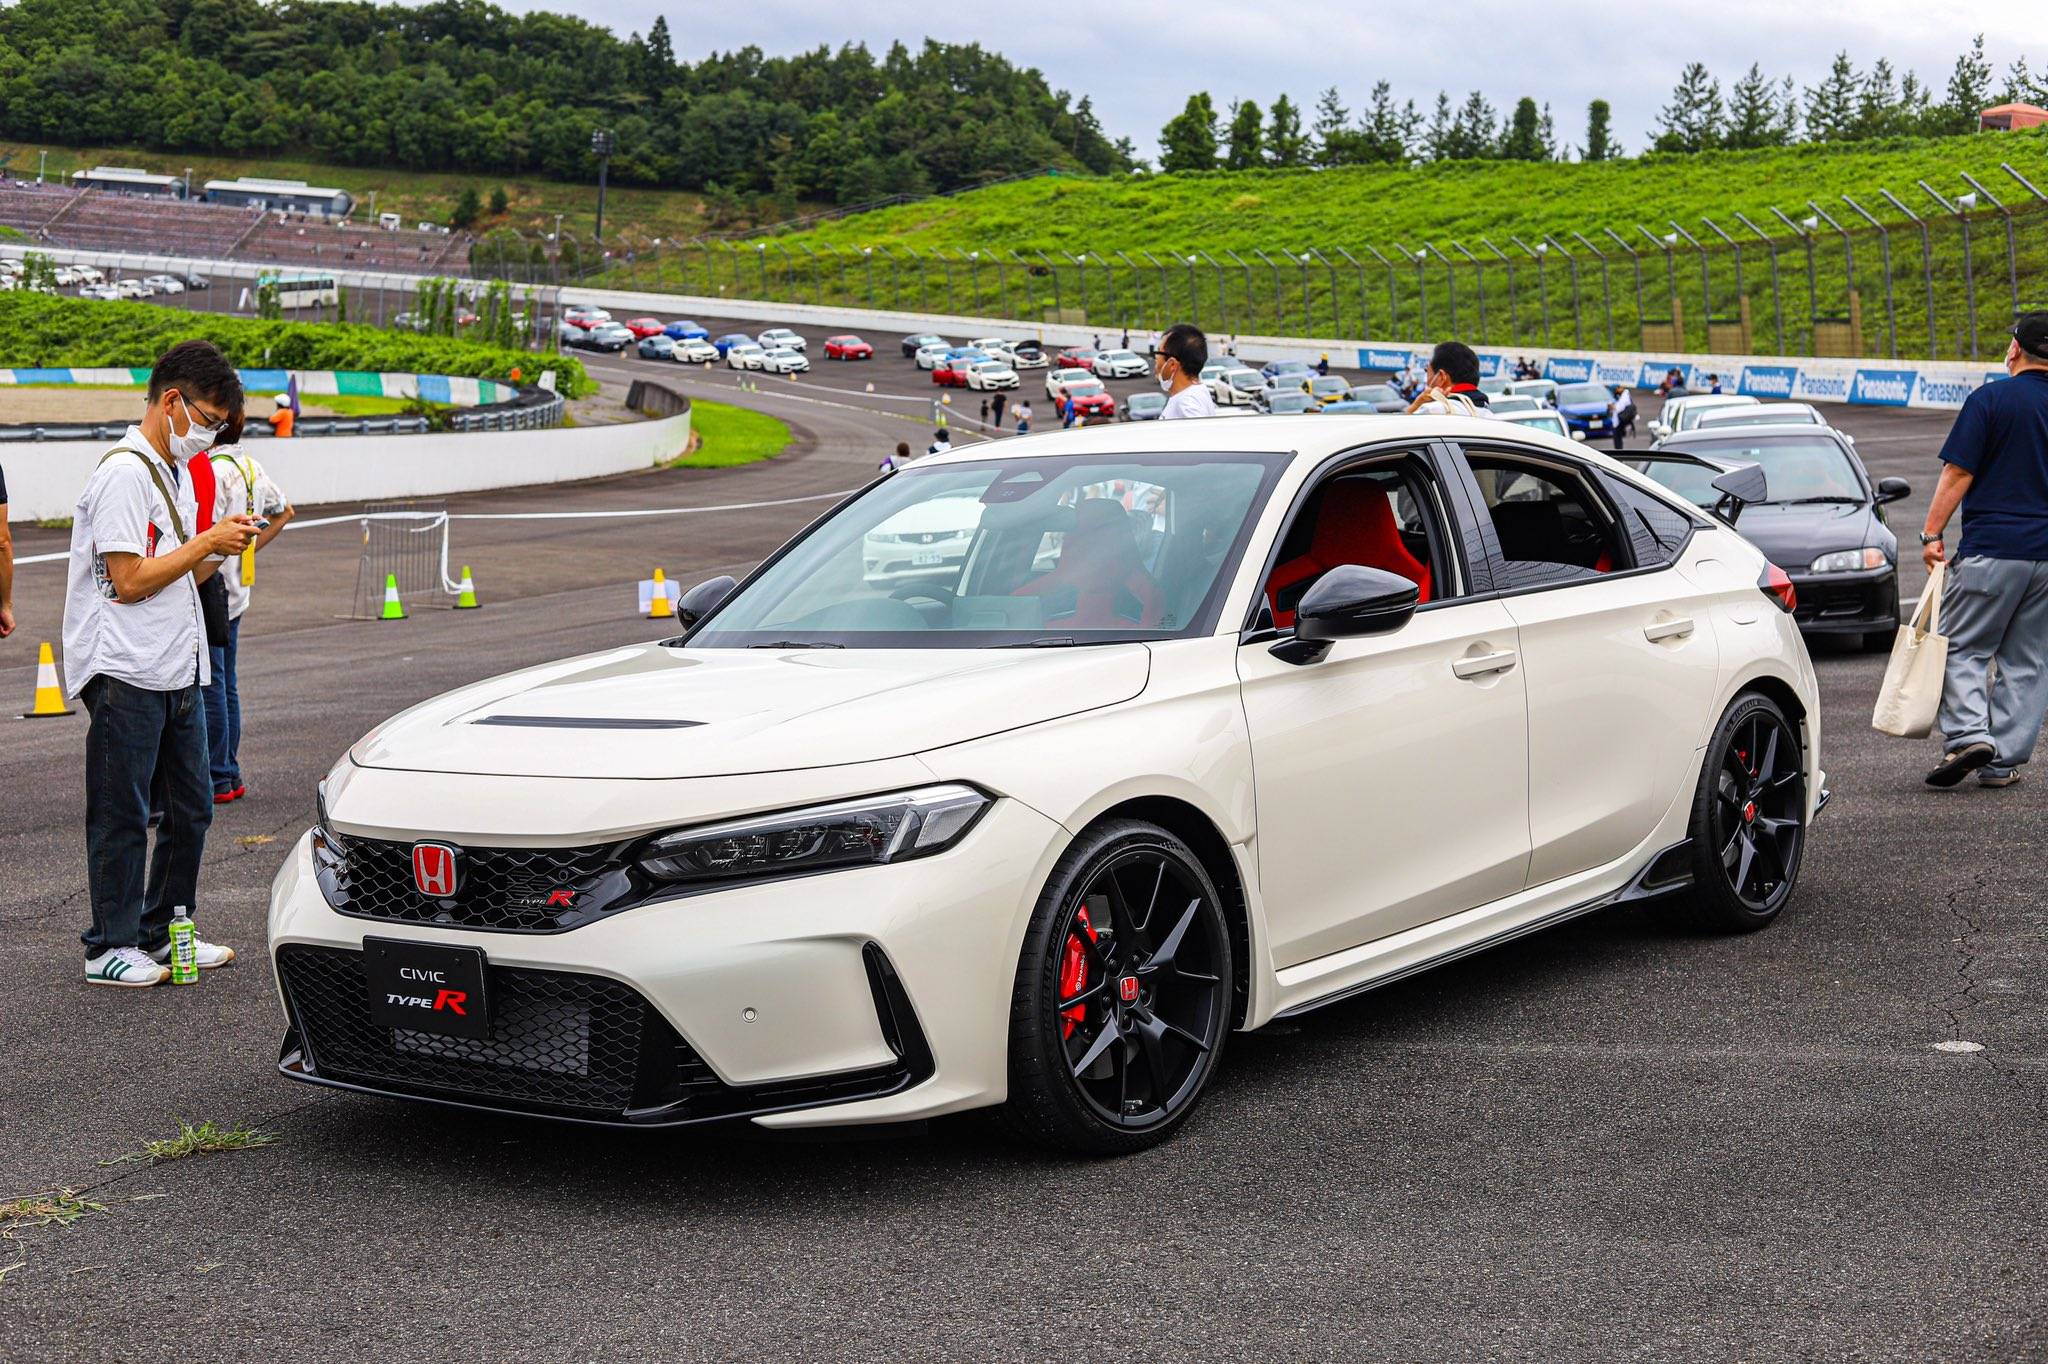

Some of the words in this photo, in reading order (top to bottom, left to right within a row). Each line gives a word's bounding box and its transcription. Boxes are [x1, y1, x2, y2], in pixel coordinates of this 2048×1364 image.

[1857, 373, 1907, 401] Panasonic
[546, 890, 576, 907] R
[400, 967, 446, 984] CIVIC
[386, 993, 433, 1009] TYPE
[433, 989, 467, 1016] R
